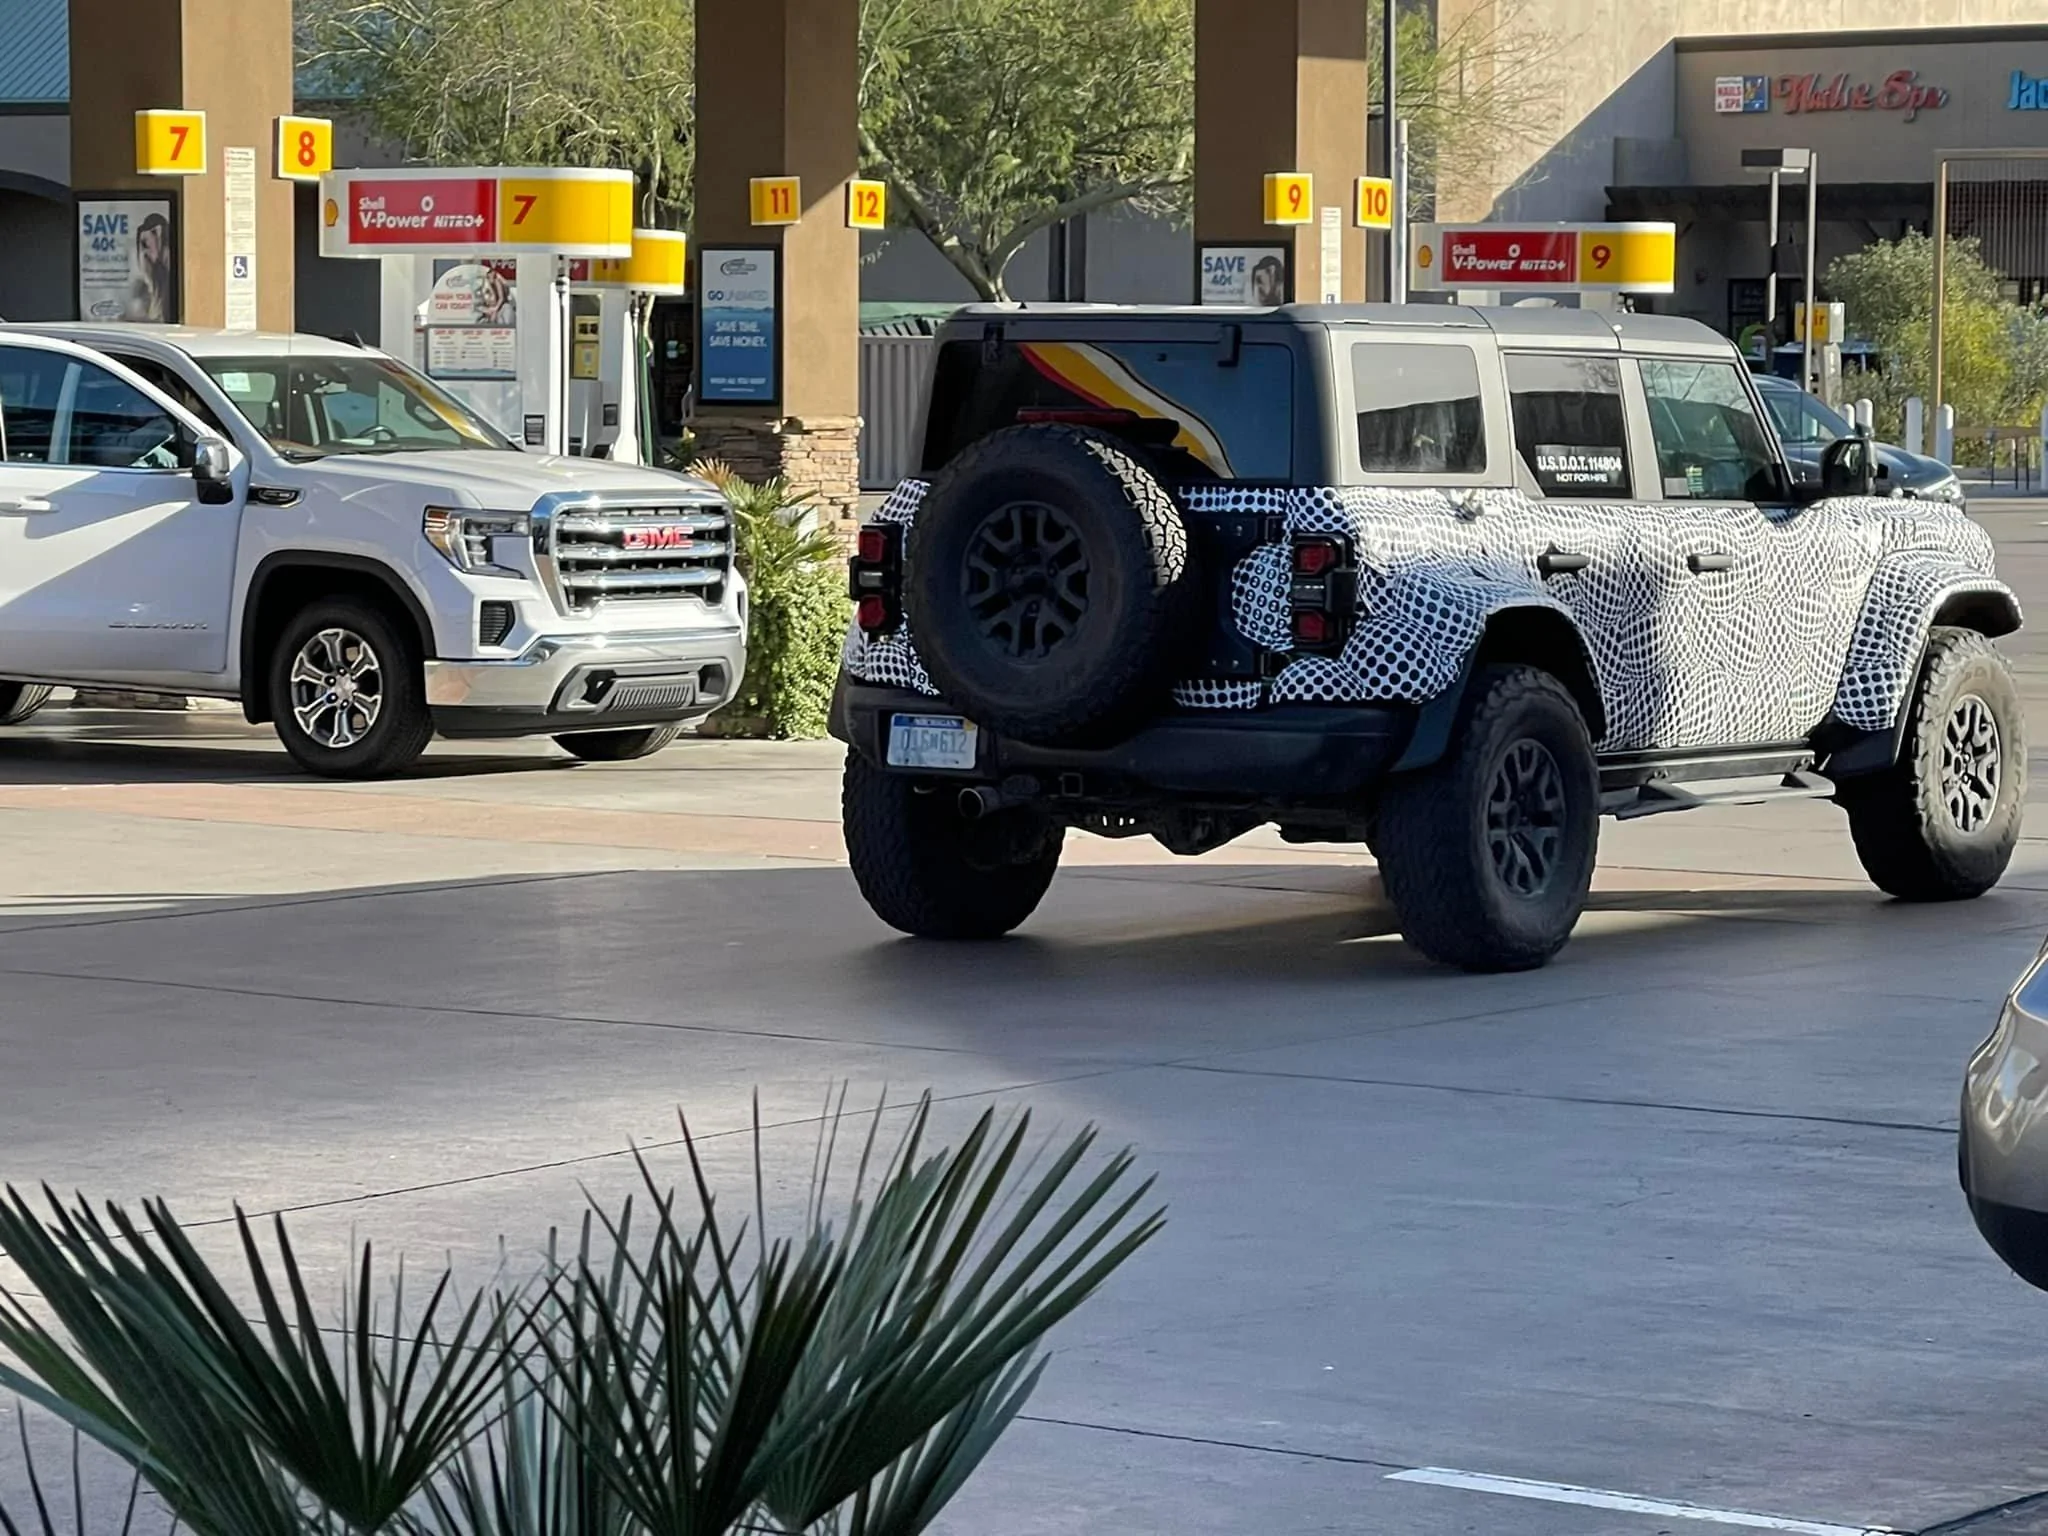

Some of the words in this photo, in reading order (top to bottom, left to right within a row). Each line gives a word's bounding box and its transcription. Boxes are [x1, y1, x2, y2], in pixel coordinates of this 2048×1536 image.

[1850, 82, 1872, 111] &
[1876, 69, 1946, 122] Spa
[169, 126, 189, 161] 7
[298, 130, 316, 167] 8
[358, 196, 385, 210] Shell
[512, 195, 538, 225] 7
[771, 188, 789, 214] 11
[857, 190, 878, 218] 12
[1288, 183, 1302, 213] 9
[1365, 187, 1388, 217] 10
[83, 214, 128, 235] SAVE
[359, 212, 428, 228] V-Power
[1204, 256, 1245, 272] SAVE
[1452, 256, 1515, 270] V-Power
[1591, 244, 1611, 269] 9
[707, 290, 724, 301] GO
[1556, 473, 1573, 482] NOT
[623, 527, 694, 549] GMC
